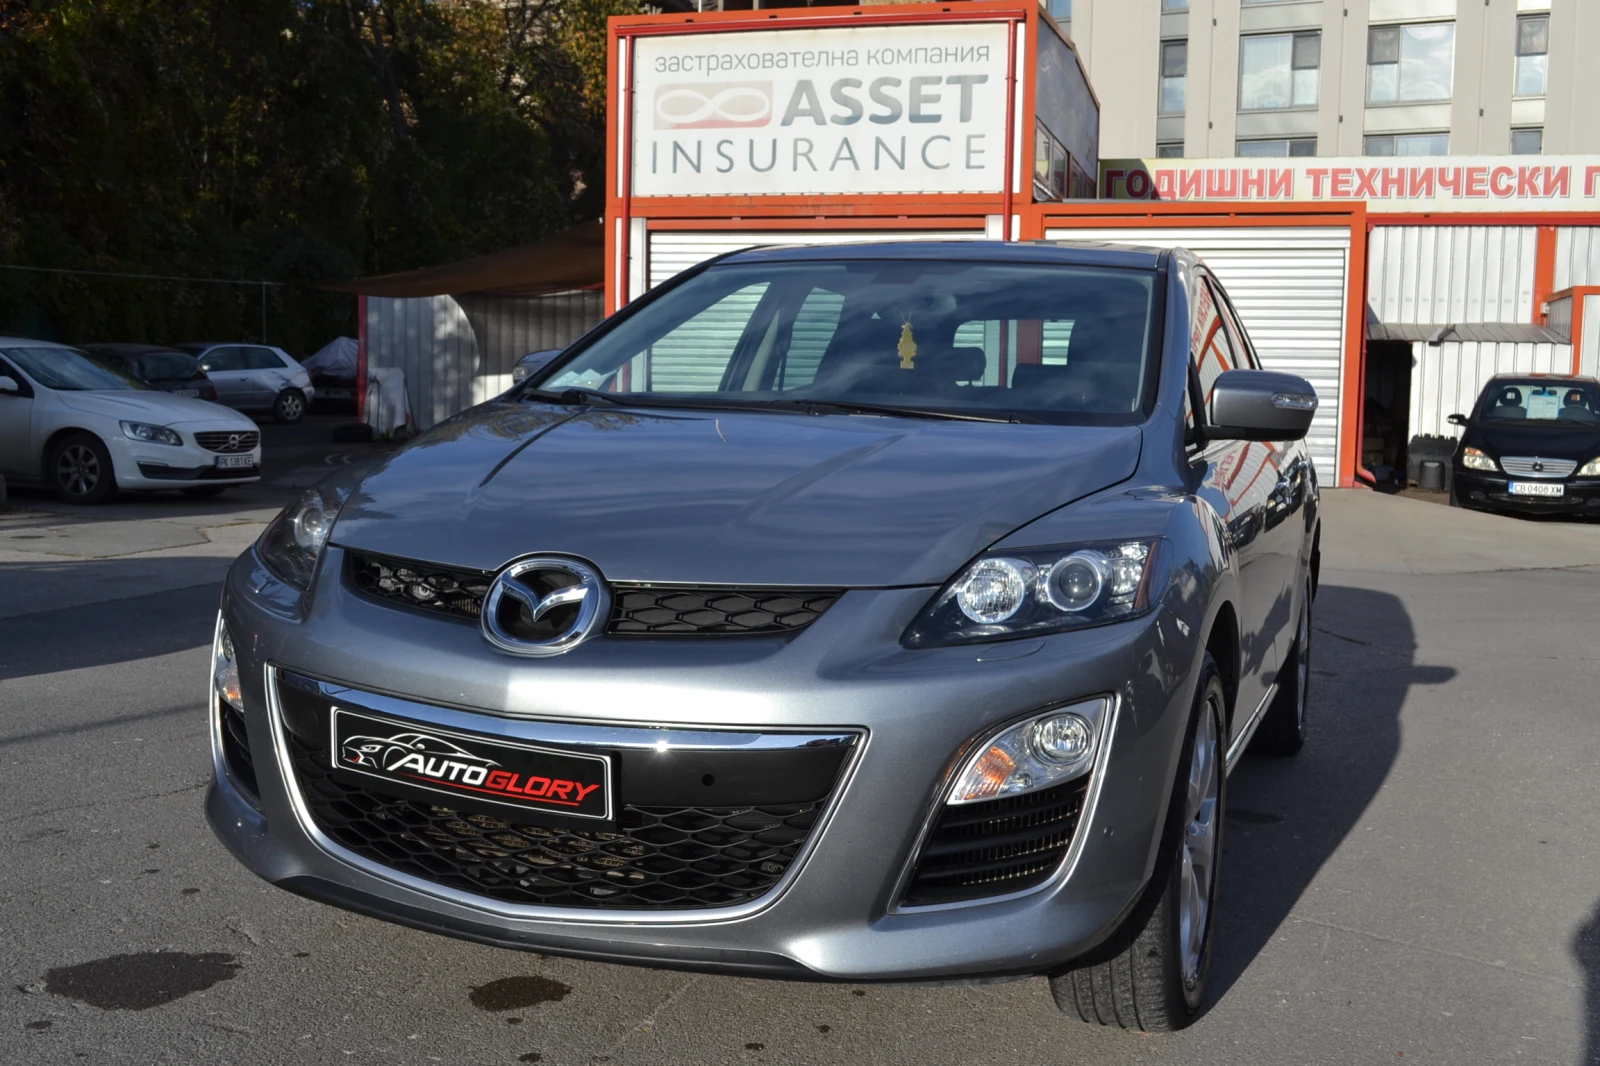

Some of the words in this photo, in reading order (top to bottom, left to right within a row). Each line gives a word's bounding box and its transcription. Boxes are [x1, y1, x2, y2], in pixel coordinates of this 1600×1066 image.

[654, 49, 859, 76] застрахователна
[867, 45, 990, 65] компания
[780, 74, 989, 127] ASSET
[651, 134, 987, 174] INSURANCE
[1105, 167, 1294, 200] ГОДИШНИ
[1305, 165, 1571, 198] ТЕХНИЧЕСКИ
[1527, 484, 1549, 494] 0408
